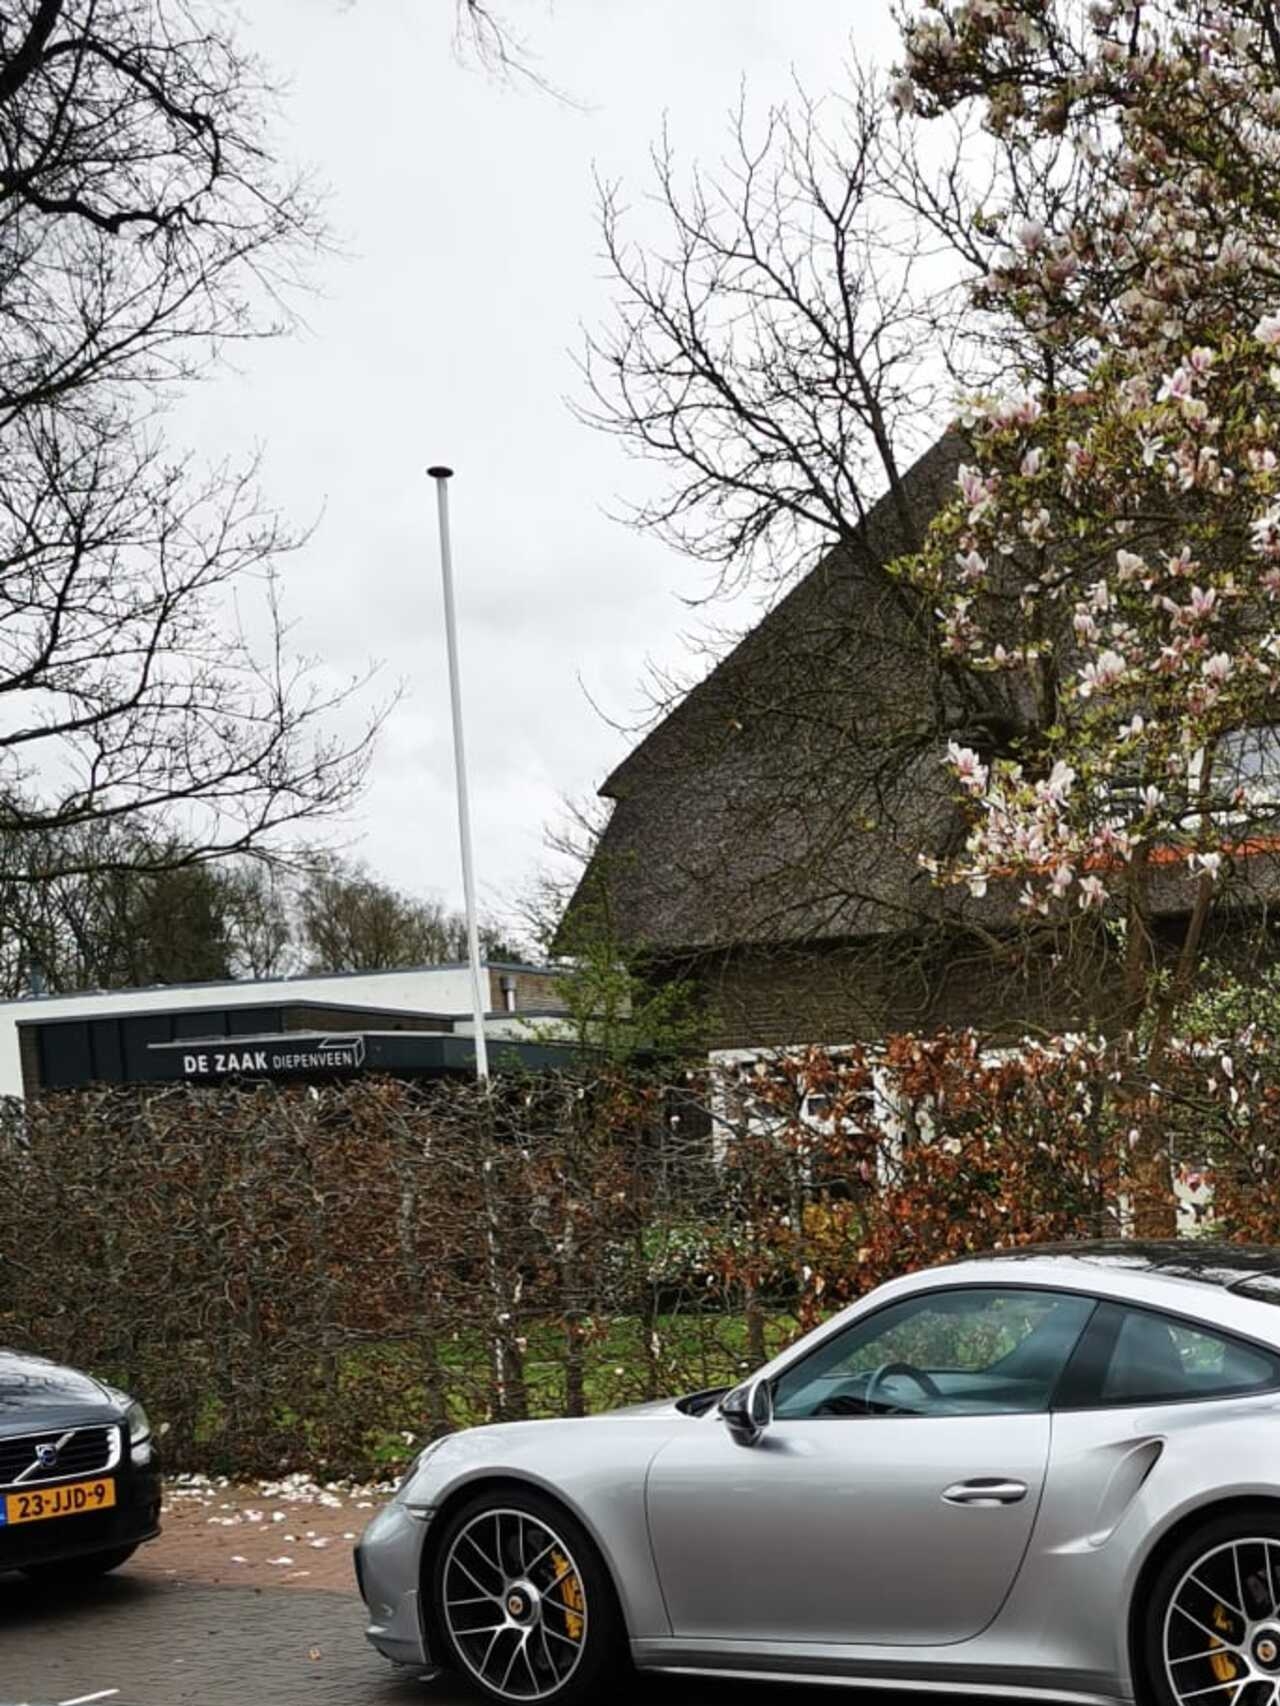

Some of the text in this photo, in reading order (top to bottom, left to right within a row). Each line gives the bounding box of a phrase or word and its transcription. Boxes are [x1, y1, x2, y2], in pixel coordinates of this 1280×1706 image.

[184, 1051, 352, 1073] DE ZAAK DIEPENVEEN
[17, 1483, 106, 1519] 23-JJD-9
